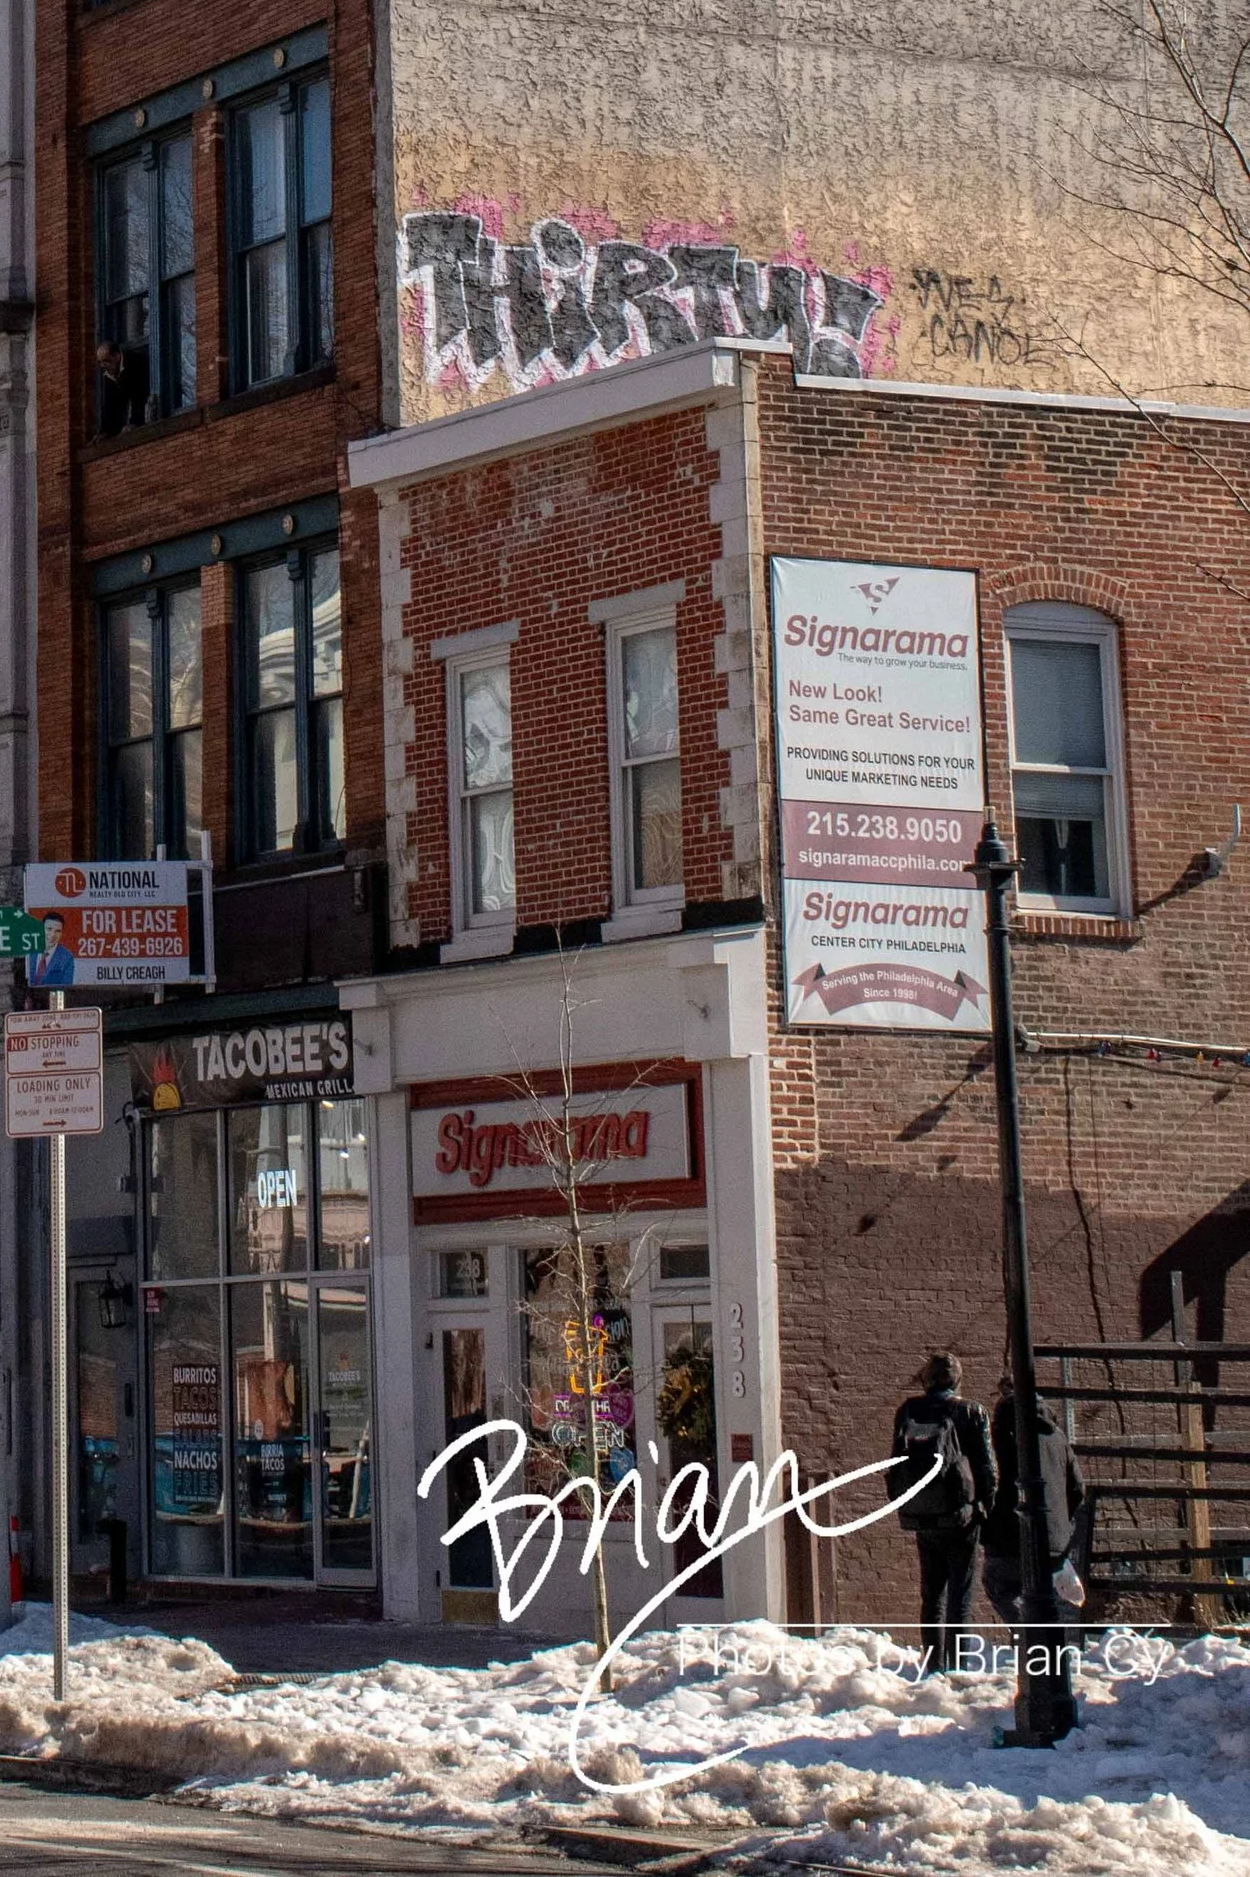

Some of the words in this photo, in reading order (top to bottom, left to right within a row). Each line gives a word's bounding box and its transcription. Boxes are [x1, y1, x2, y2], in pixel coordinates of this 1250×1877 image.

[784, 614, 969, 658] Signarama
[838, 652, 854, 664] The
[855, 656, 872, 666] way
[875, 656, 884, 665] to
[886, 658, 907, 668] grow
[909, 660, 927, 669] your
[929, 659, 968, 672] business.
[789, 680, 827, 699] New
[833, 683, 882, 703] Look!
[789, 705, 839, 725] Same
[845, 709, 894, 728] Great
[899, 712, 970, 733] Service!
[787, 747, 849, 763] PROVIDING
[852, 752, 915, 767] SOLUTIONS
[918, 756, 941, 768] FOR
[944, 757, 975, 771] YOUR
[806, 769, 848, 783] UNIQUE
[852, 771, 917, 787] MARKETING
[921, 776, 958, 790] NEEDS
[806, 811, 962, 844] 215.238.9050
[89, 871, 159, 889] NATIONAL
[82, 909, 116, 934] FOR
[122, 908, 177, 933] LEASE
[803, 892, 969, 930] Signarama
[21, 933, 41, 952] ST
[77, 936, 183, 957] 267-439-6926
[811, 935, 855, 948] CENTER
[858, 937, 882, 949] CITY
[886, 939, 966, 954] PHILADELPHIA
[96, 966, 122, 980] BILLY
[125, 965, 166, 980] CREAGH
[821, 973, 858, 991] Serving
[859, 970, 875, 982] the
[876, 969, 935, 988] Philadelphia
[936, 982, 958, 998] Area
[863, 987, 890, 999] Since
[10, 1037, 27, 1051] NO
[31, 1035, 79, 1050] STOPPING
[192, 1021, 348, 1083] TACOBEE'S
[17, 1079, 60, 1094] LOADING
[65, 1078, 90, 1090] ONLY
[266, 1082, 314, 1100] MEXICAN
[435, 1109, 651, 1187] Signarama
[257, 1170, 298, 1208] OPEN
[172, 1367, 218, 1385] BURRITOS
[172, 1385, 218, 1411] TACOS
[172, 1412, 218, 1427] QUESADILLAS
[173, 1450, 218, 1471] NACHOS
[261, 1457, 285, 1471] TACOS
